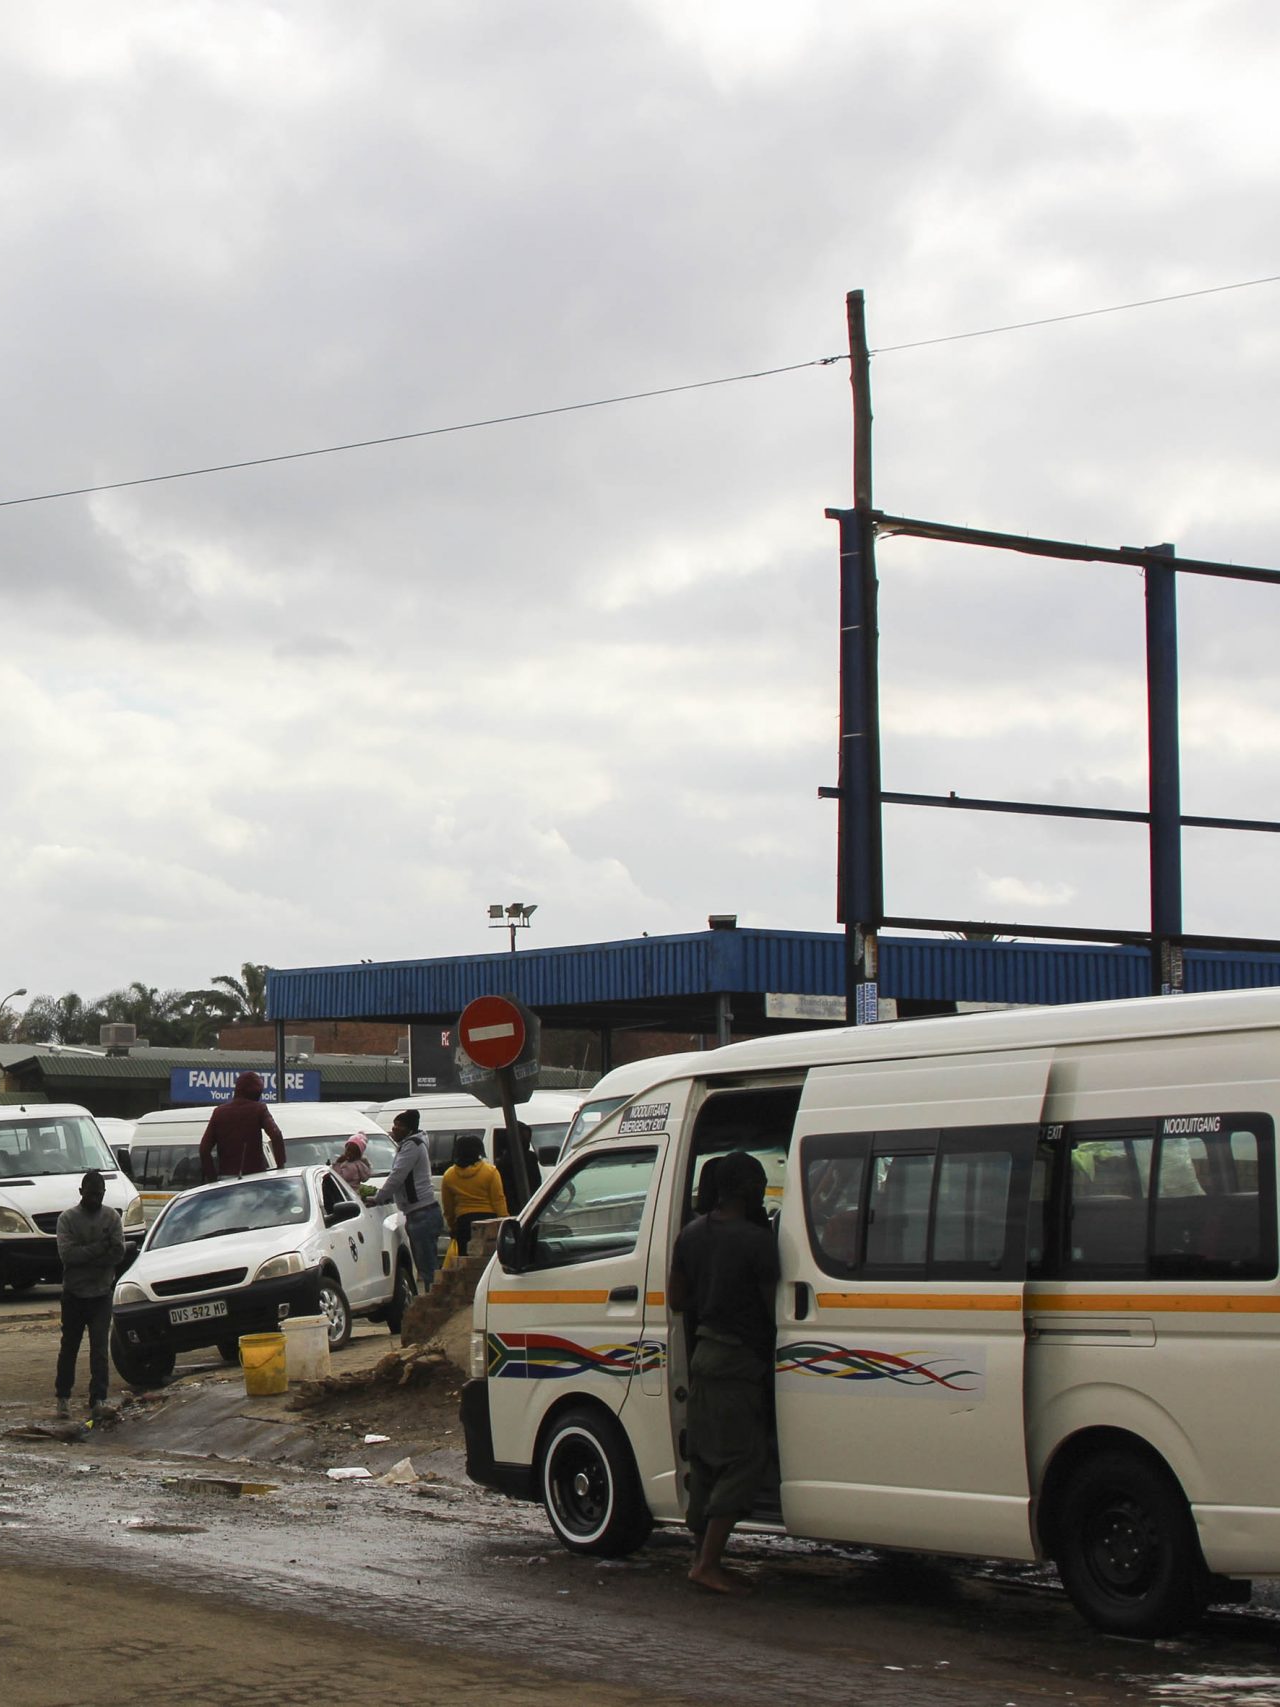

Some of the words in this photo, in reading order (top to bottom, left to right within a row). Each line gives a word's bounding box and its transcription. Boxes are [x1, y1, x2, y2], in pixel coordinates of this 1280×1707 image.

[189, 1071, 240, 1088] FAMIL
[210, 1091, 230, 1100] Your
[620, 1120, 653, 1133] EMERGENCY
[652, 1118, 666, 1131] EXIT
[1047, 1125, 1064, 1140] EXIT
[1163, 1116, 1221, 1134] NOODUITGANG
[171, 1309, 189, 1322] DVS
[191, 1306, 211, 1318] 572
[214, 1303, 226, 1315] MP
